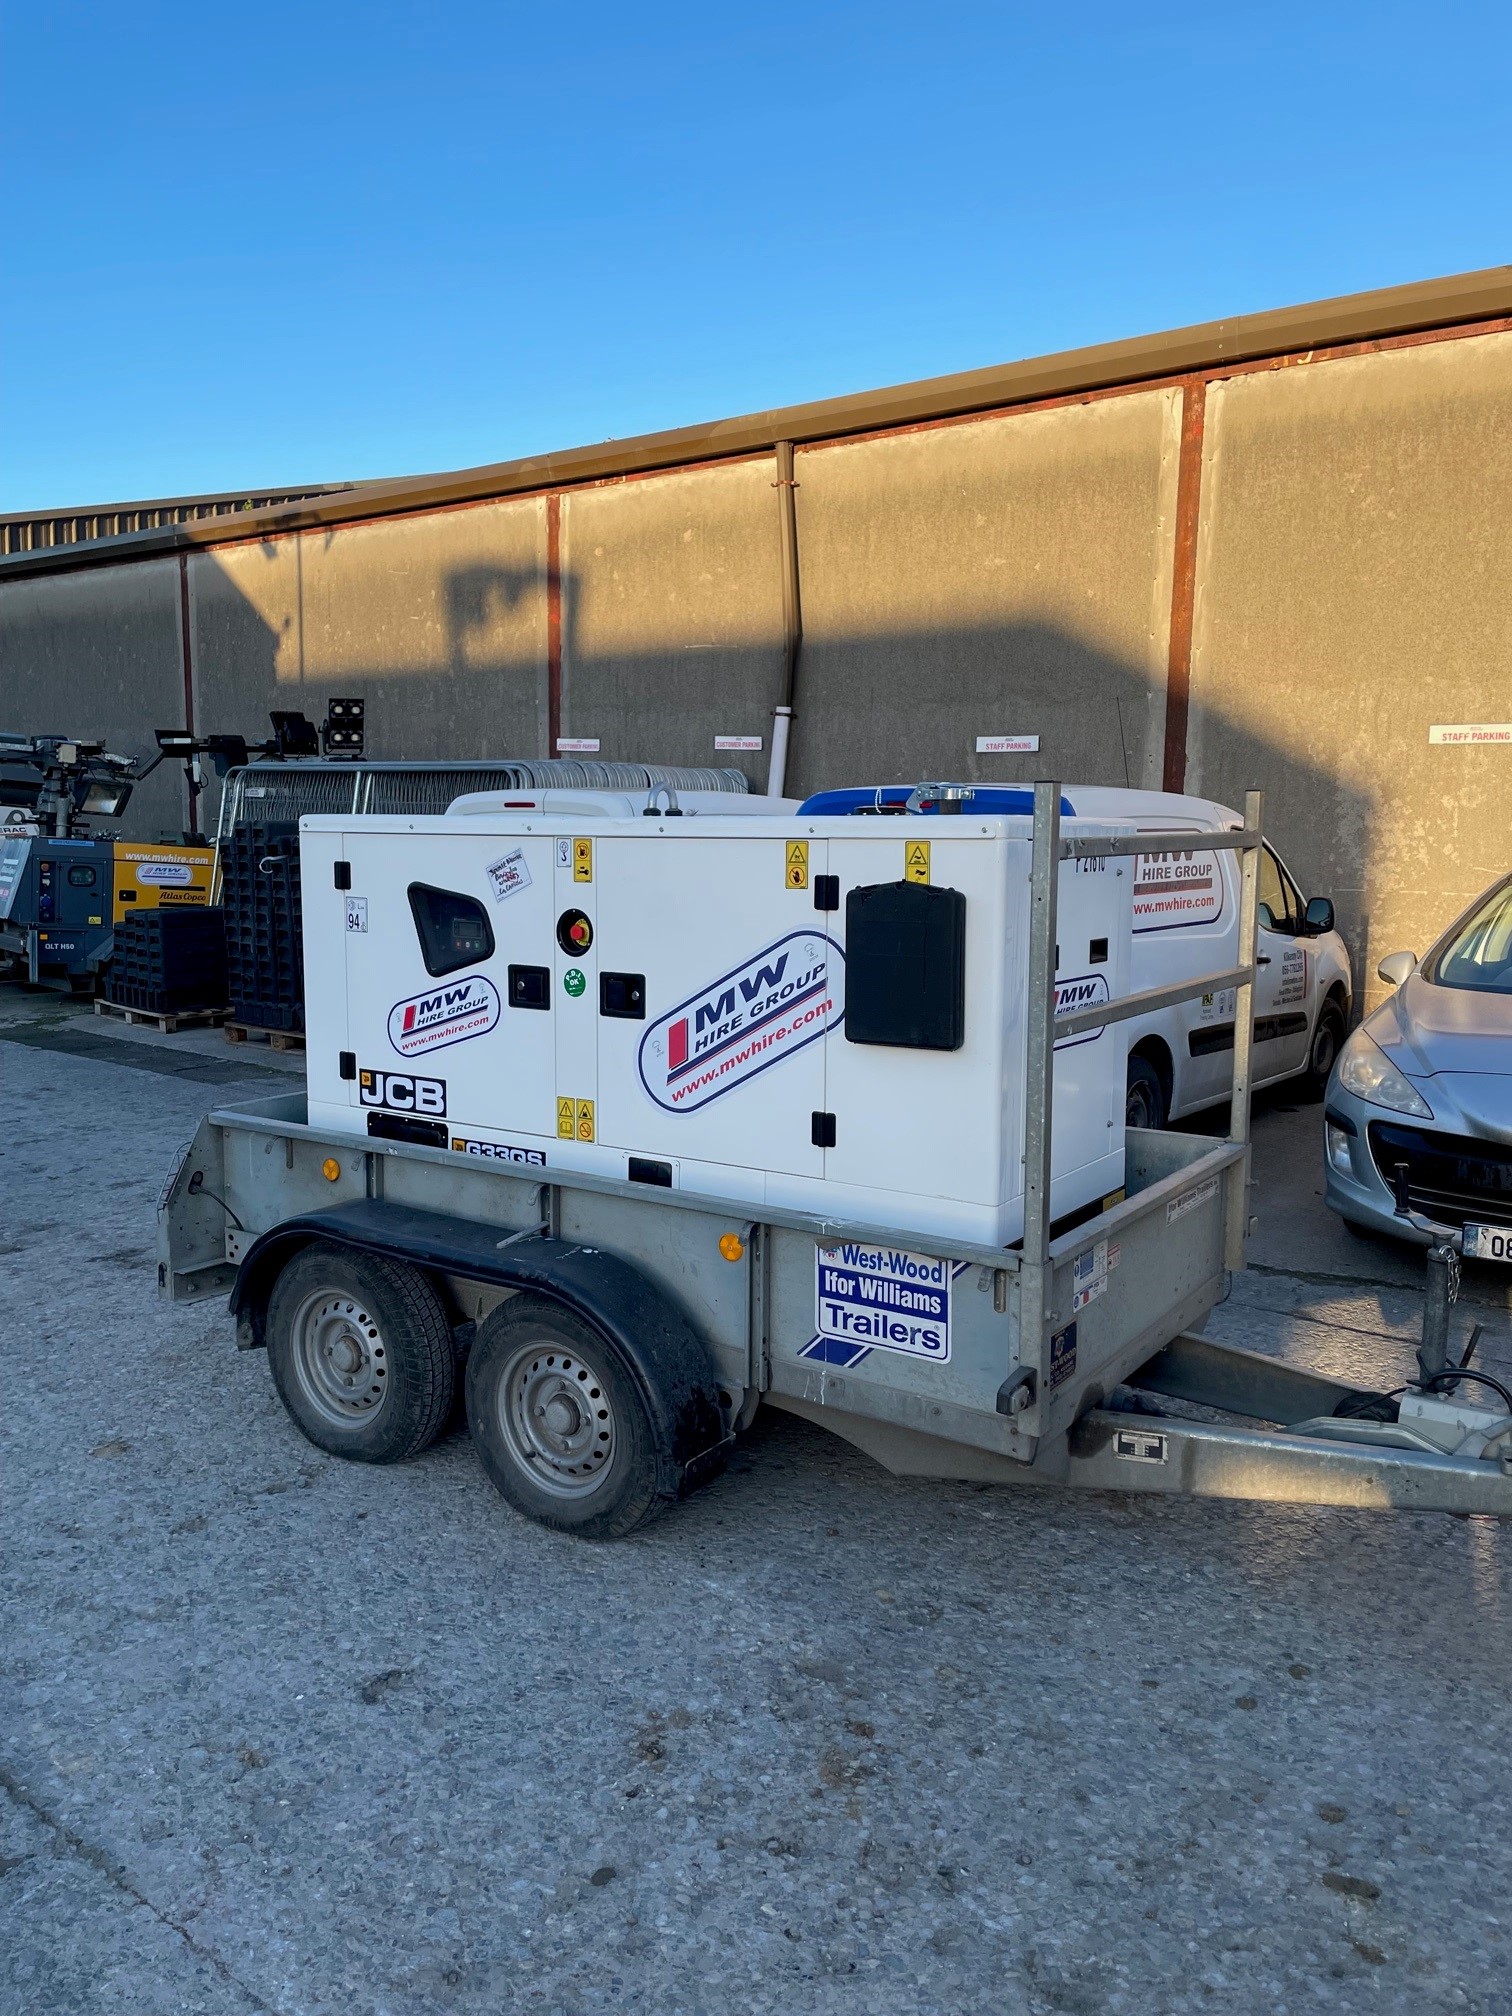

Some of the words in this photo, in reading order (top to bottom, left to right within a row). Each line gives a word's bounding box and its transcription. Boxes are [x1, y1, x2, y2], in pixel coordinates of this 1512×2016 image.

[1006, 742, 1031, 750] PARKING
[1442, 732, 1470, 741] STAFF
[1472, 731, 1511, 741] PARKING
[125, 853, 209, 864] www.mwhire.com
[1142, 866, 1172, 880] HIRE
[1174, 864, 1212, 878] GROUP
[159, 892, 182, 900] Atlas
[183, 893, 206, 902] Copco
[1133, 896, 1215, 914] ww.mwhire.com
[348, 913, 360, 929] 94
[419, 985, 472, 1015] MW
[694, 1014, 743, 1053] HIRE
[750, 962, 826, 1018] GROUP
[695, 951, 790, 1035] MW
[1060, 983, 1097, 1005] MW
[417, 1011, 445, 1026] HIRE
[447, 996, 489, 1016] GROUP
[402, 1016, 489, 1050] www.mwhire.com
[671, 998, 833, 1102] www.mwhire.com
[361, 1074, 445, 1114] JCB
[842, 1243, 943, 1283] West-Wood
[825, 1270, 856, 1296] Ifor
[858, 1277, 942, 1314] Williams
[825, 1302, 941, 1350] Trailers
